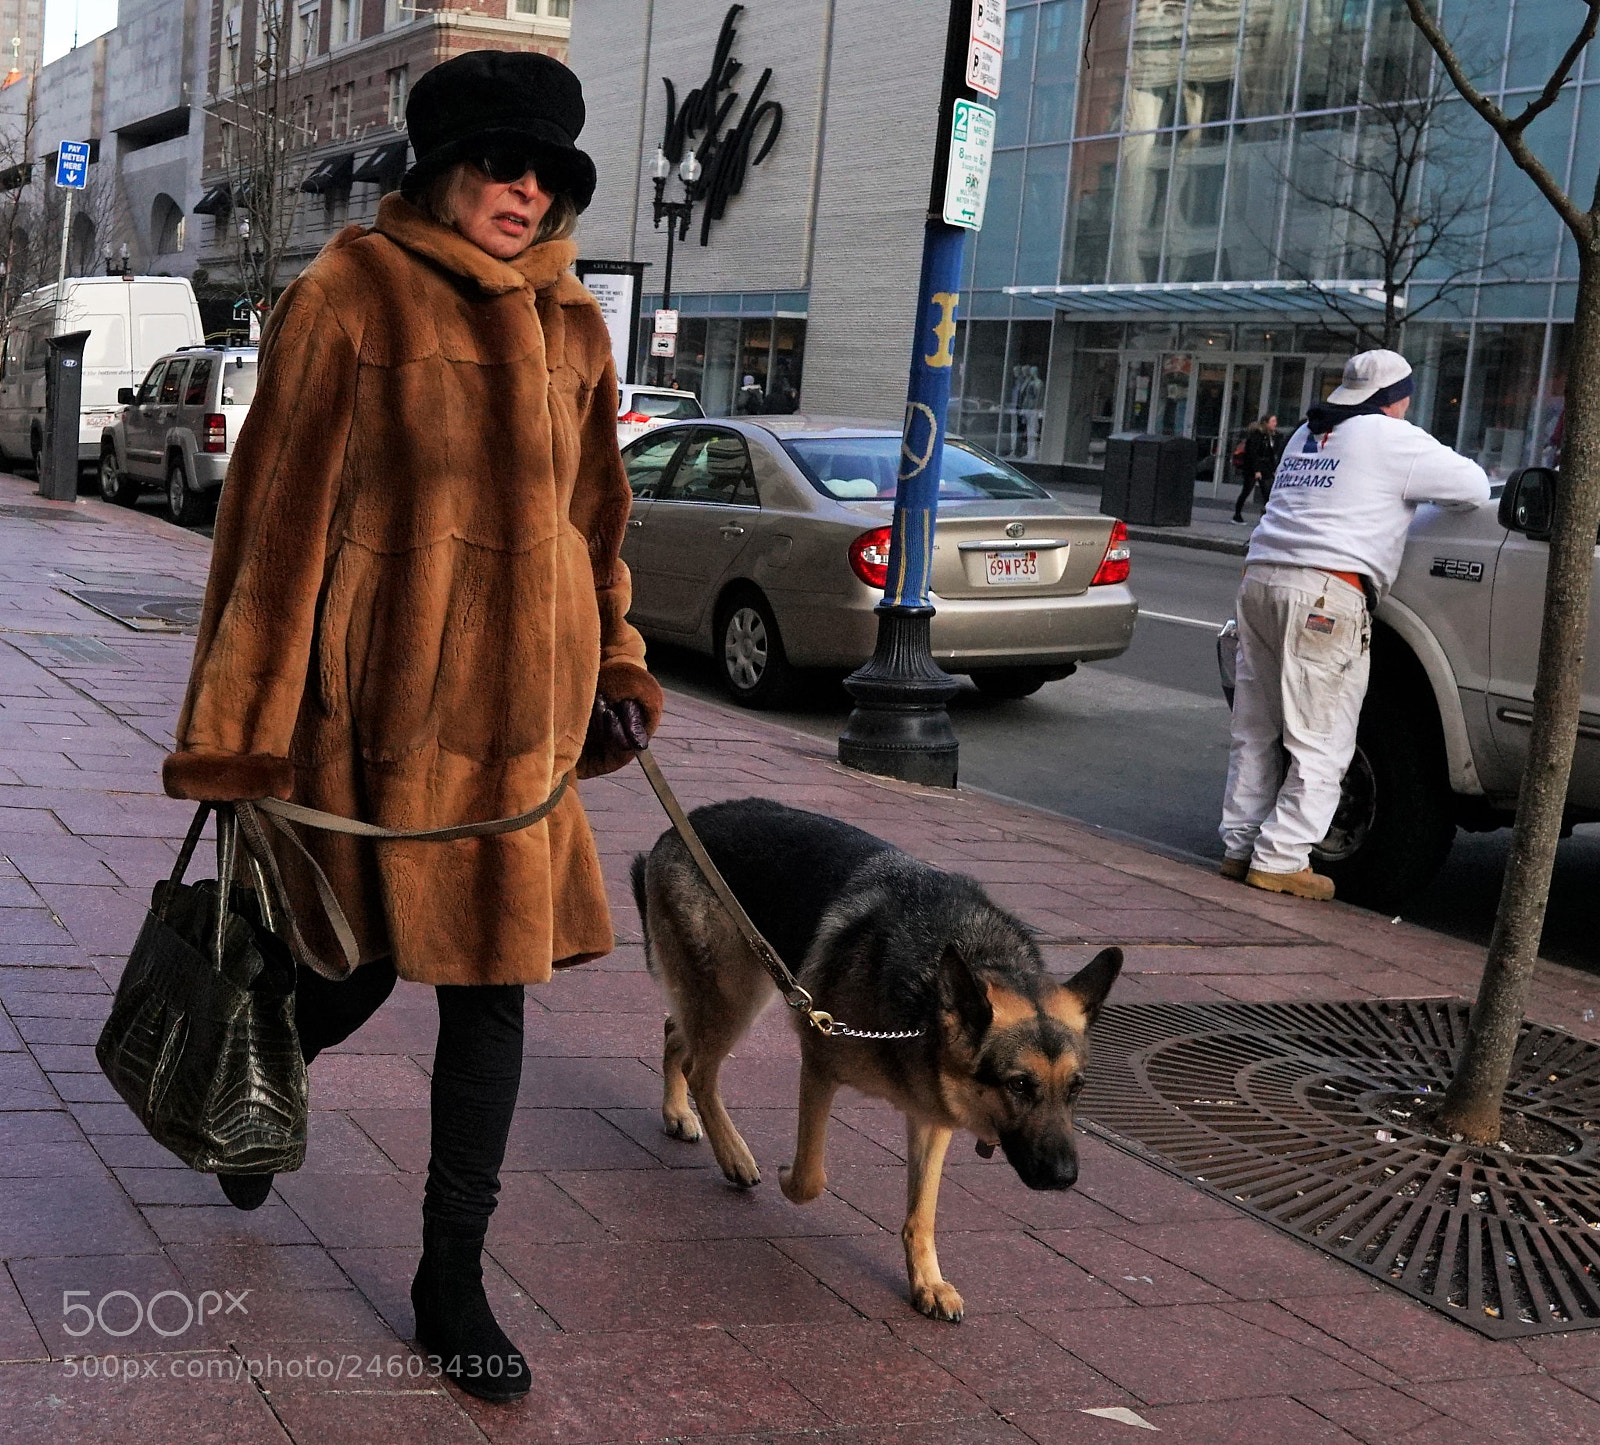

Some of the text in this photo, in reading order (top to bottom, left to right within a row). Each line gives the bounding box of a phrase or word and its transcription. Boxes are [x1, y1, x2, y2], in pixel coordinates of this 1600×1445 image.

[956, 107, 968, 131] 2
[67, 144, 82, 153] PAY
[61, 152, 86, 162] METER
[63, 161, 83, 171] HERE
[1280, 457, 1340, 473] SHERWIN
[1273, 473, 1335, 489] WILLIAMS
[990, 558, 1037, 576] 69W P33
